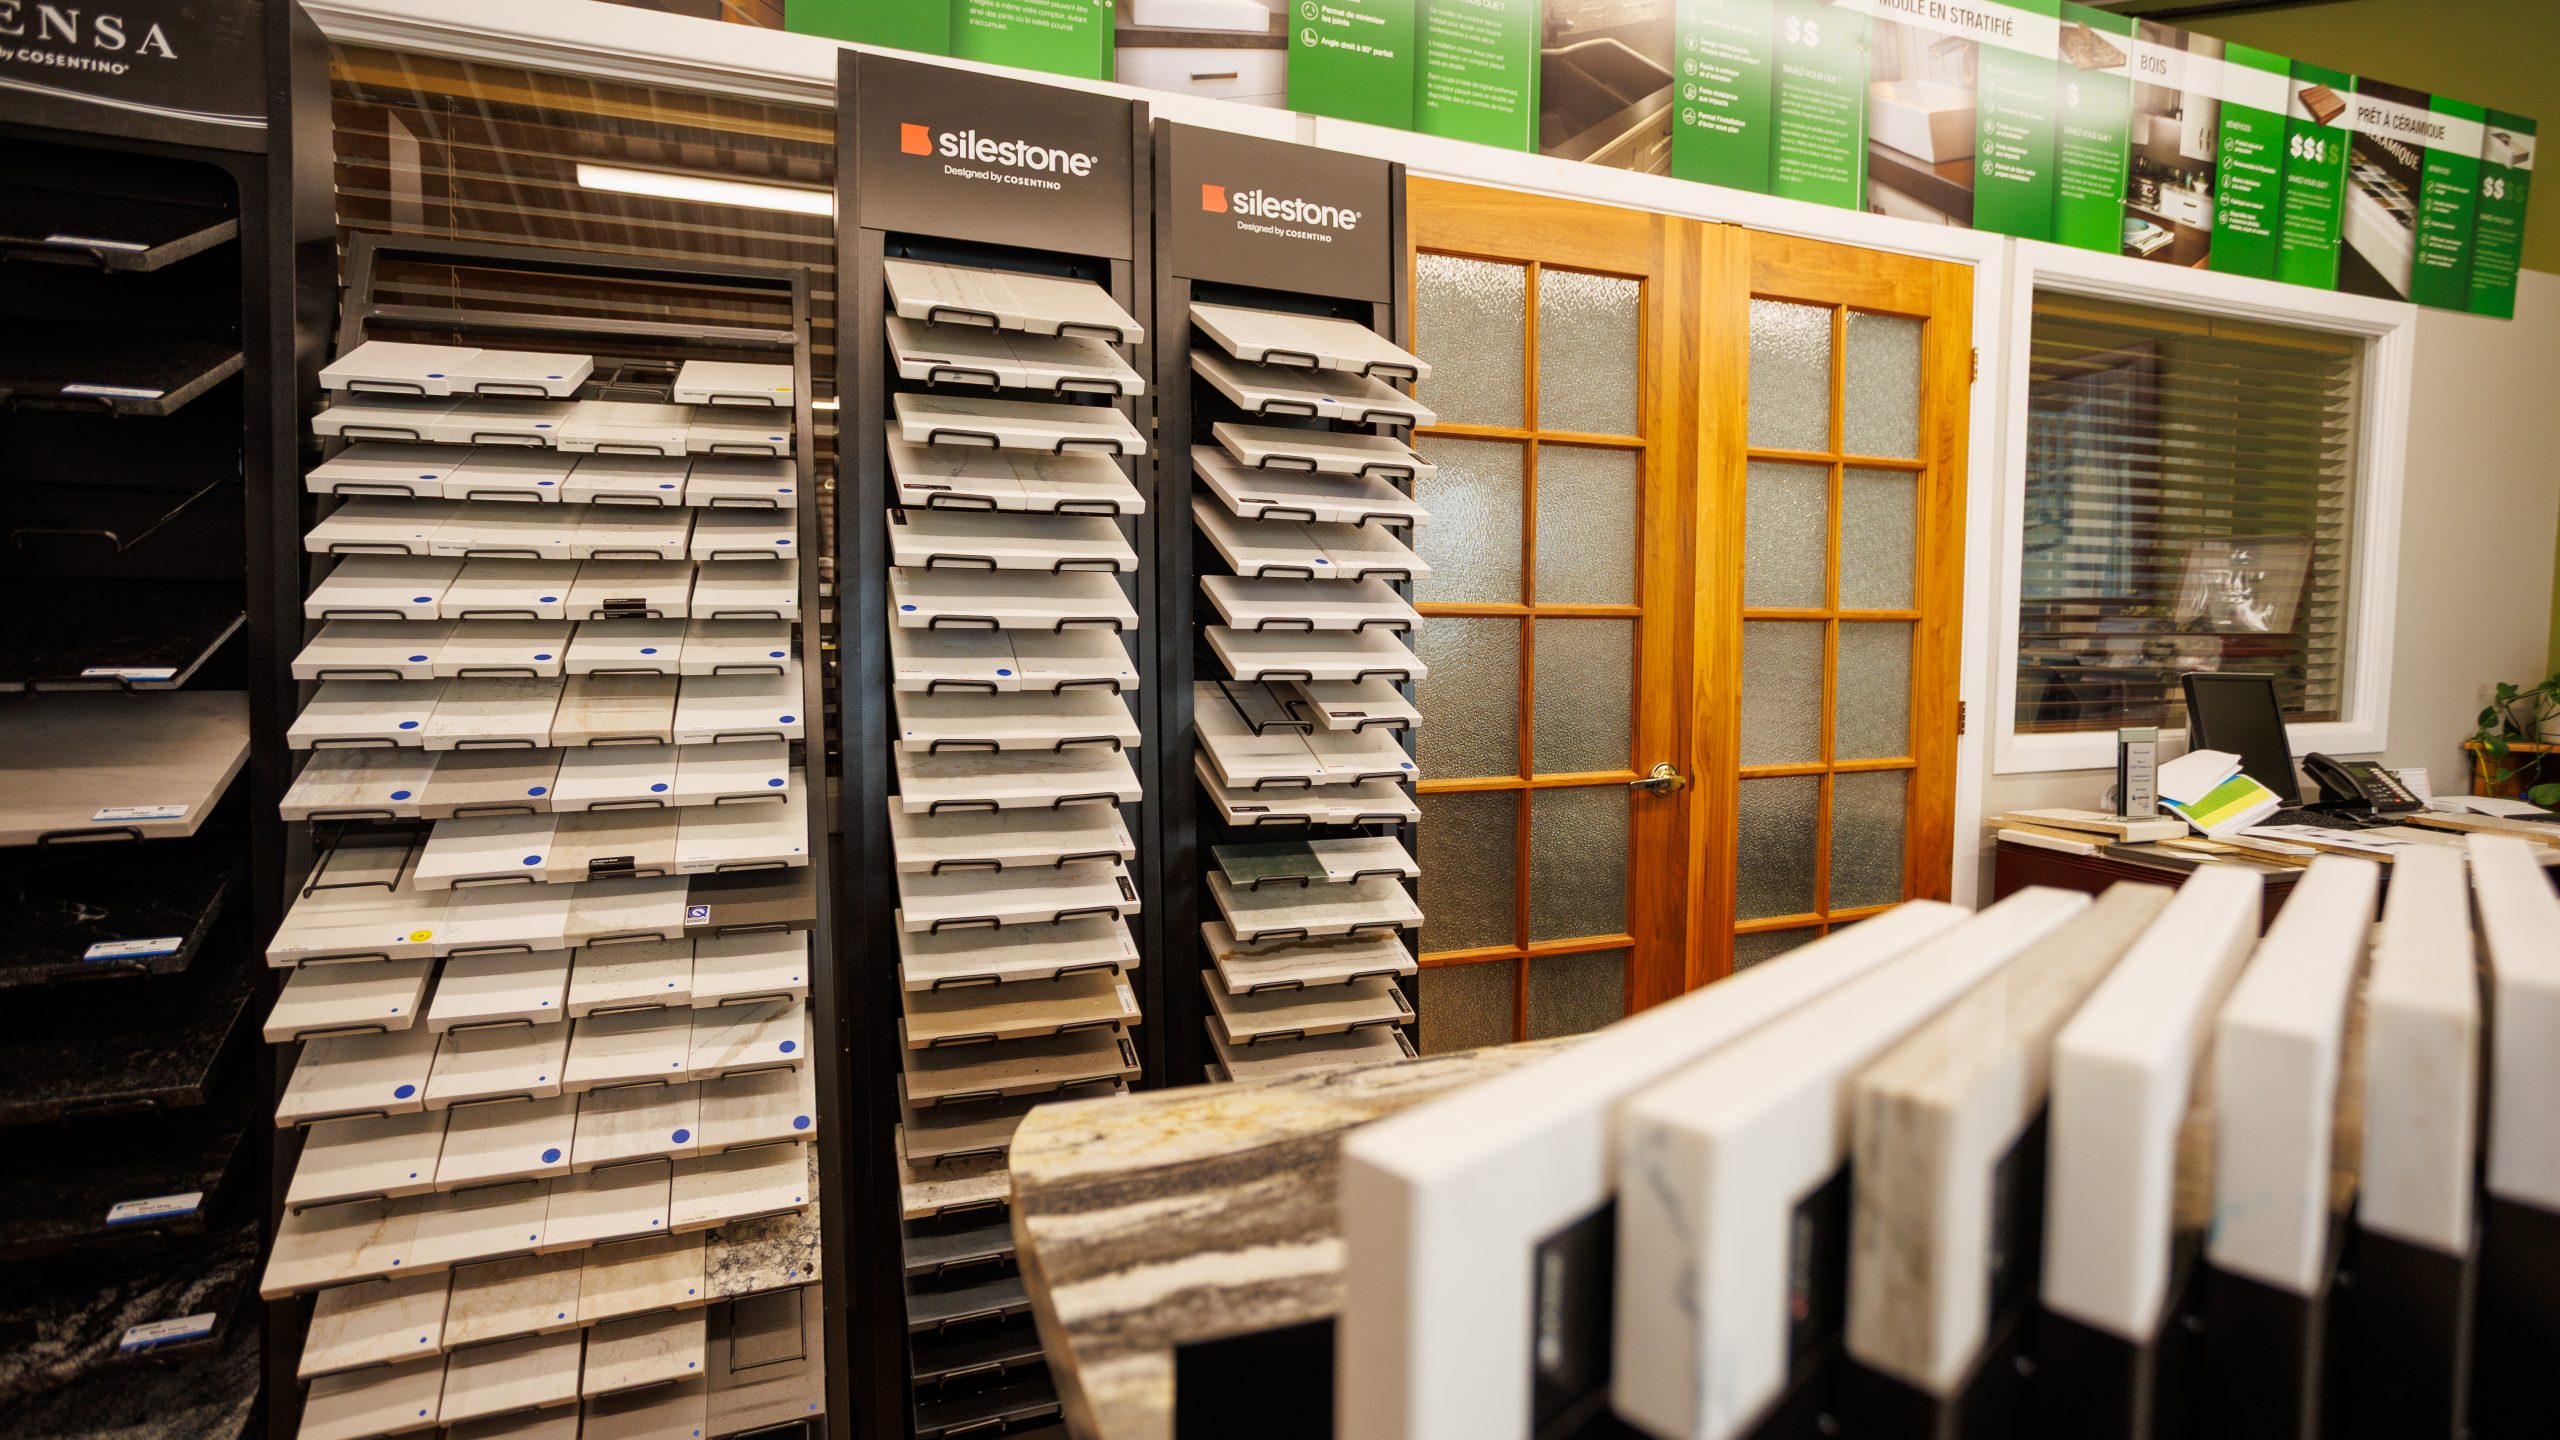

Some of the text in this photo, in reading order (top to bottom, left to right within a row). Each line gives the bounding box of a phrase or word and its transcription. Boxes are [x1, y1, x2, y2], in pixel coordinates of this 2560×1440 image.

[1322, 5, 1345, 17] Permet
[1346, 10, 1354, 19] de
[1929, 1, 1946, 21] EN
[1950, 8, 2014, 38] STRATIFIÉ
[1321, 36, 1340, 48] Angle
[1340, 41, 1356, 51] droit
[1373, 48, 1394, 58] parfait
[2140, 54, 2168, 76] BOIS
[2358, 106, 2446, 140] PRÊT À CÉRAMIQUE
[944, 164, 1061, 190] Designed by COSENTINO
[1237, 220, 1332, 242] Designed by COSENTINO
